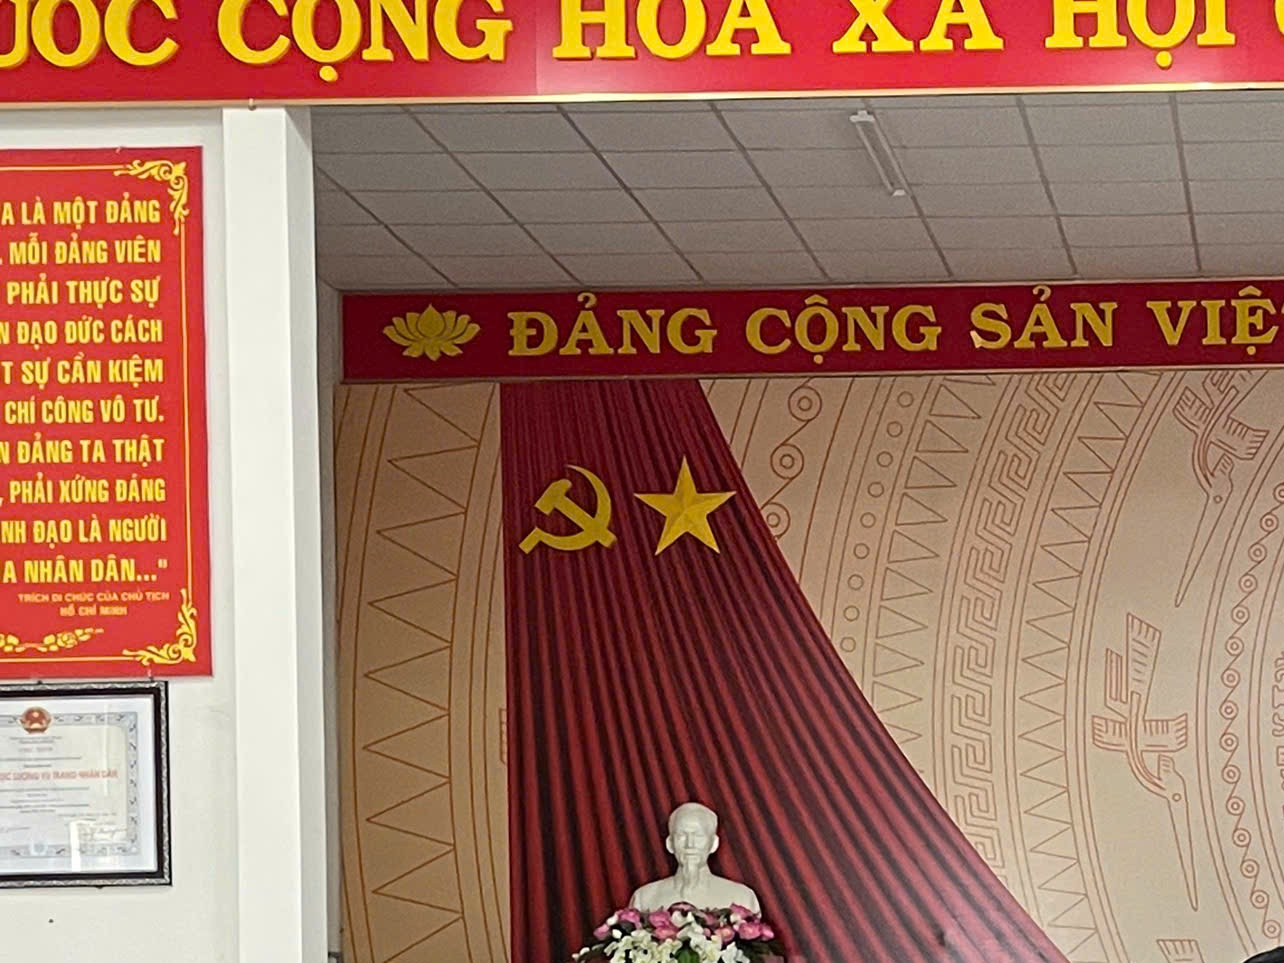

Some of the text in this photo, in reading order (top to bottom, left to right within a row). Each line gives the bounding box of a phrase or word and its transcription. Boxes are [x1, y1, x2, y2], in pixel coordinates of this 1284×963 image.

[21, 196, 46, 224] LÀ
[53, 196, 98, 229] MỘT
[105, 192, 161, 224] ĐẢNG
[9, 232, 161, 264] MỖI ĐẢNG VIÊN
[7, 272, 161, 309] PHẢI THỰC SỰ
[17, 320, 57, 350] ĐẠO
[64, 315, 105, 344] ĐỨC
[110, 314, 163, 343] CÁCH
[507, 292, 716, 356] ĐẢNG
[745, 295, 943, 365] CỘNG
[970, 285, 1118, 350] SẢN
[21, 357, 50, 389] SỰ
[108, 354, 164, 388] KIỆM
[5, 395, 35, 425] CHÍ
[41, 396, 94, 424] CÔNG
[100, 394, 126, 423] VÔ
[17, 432, 73, 464] ĐẢNG
[80, 439, 106, 463] TA
[112, 434, 165, 467] THẬT
[9, 472, 166, 503] PHẢI XỨNG ĐÁNG
[33, 519, 72, 549] ĐẠO
[79, 514, 102, 543] LÀ
[108, 513, 167, 543] NGƯỜI
[24, 555, 84, 583] NHÂN
